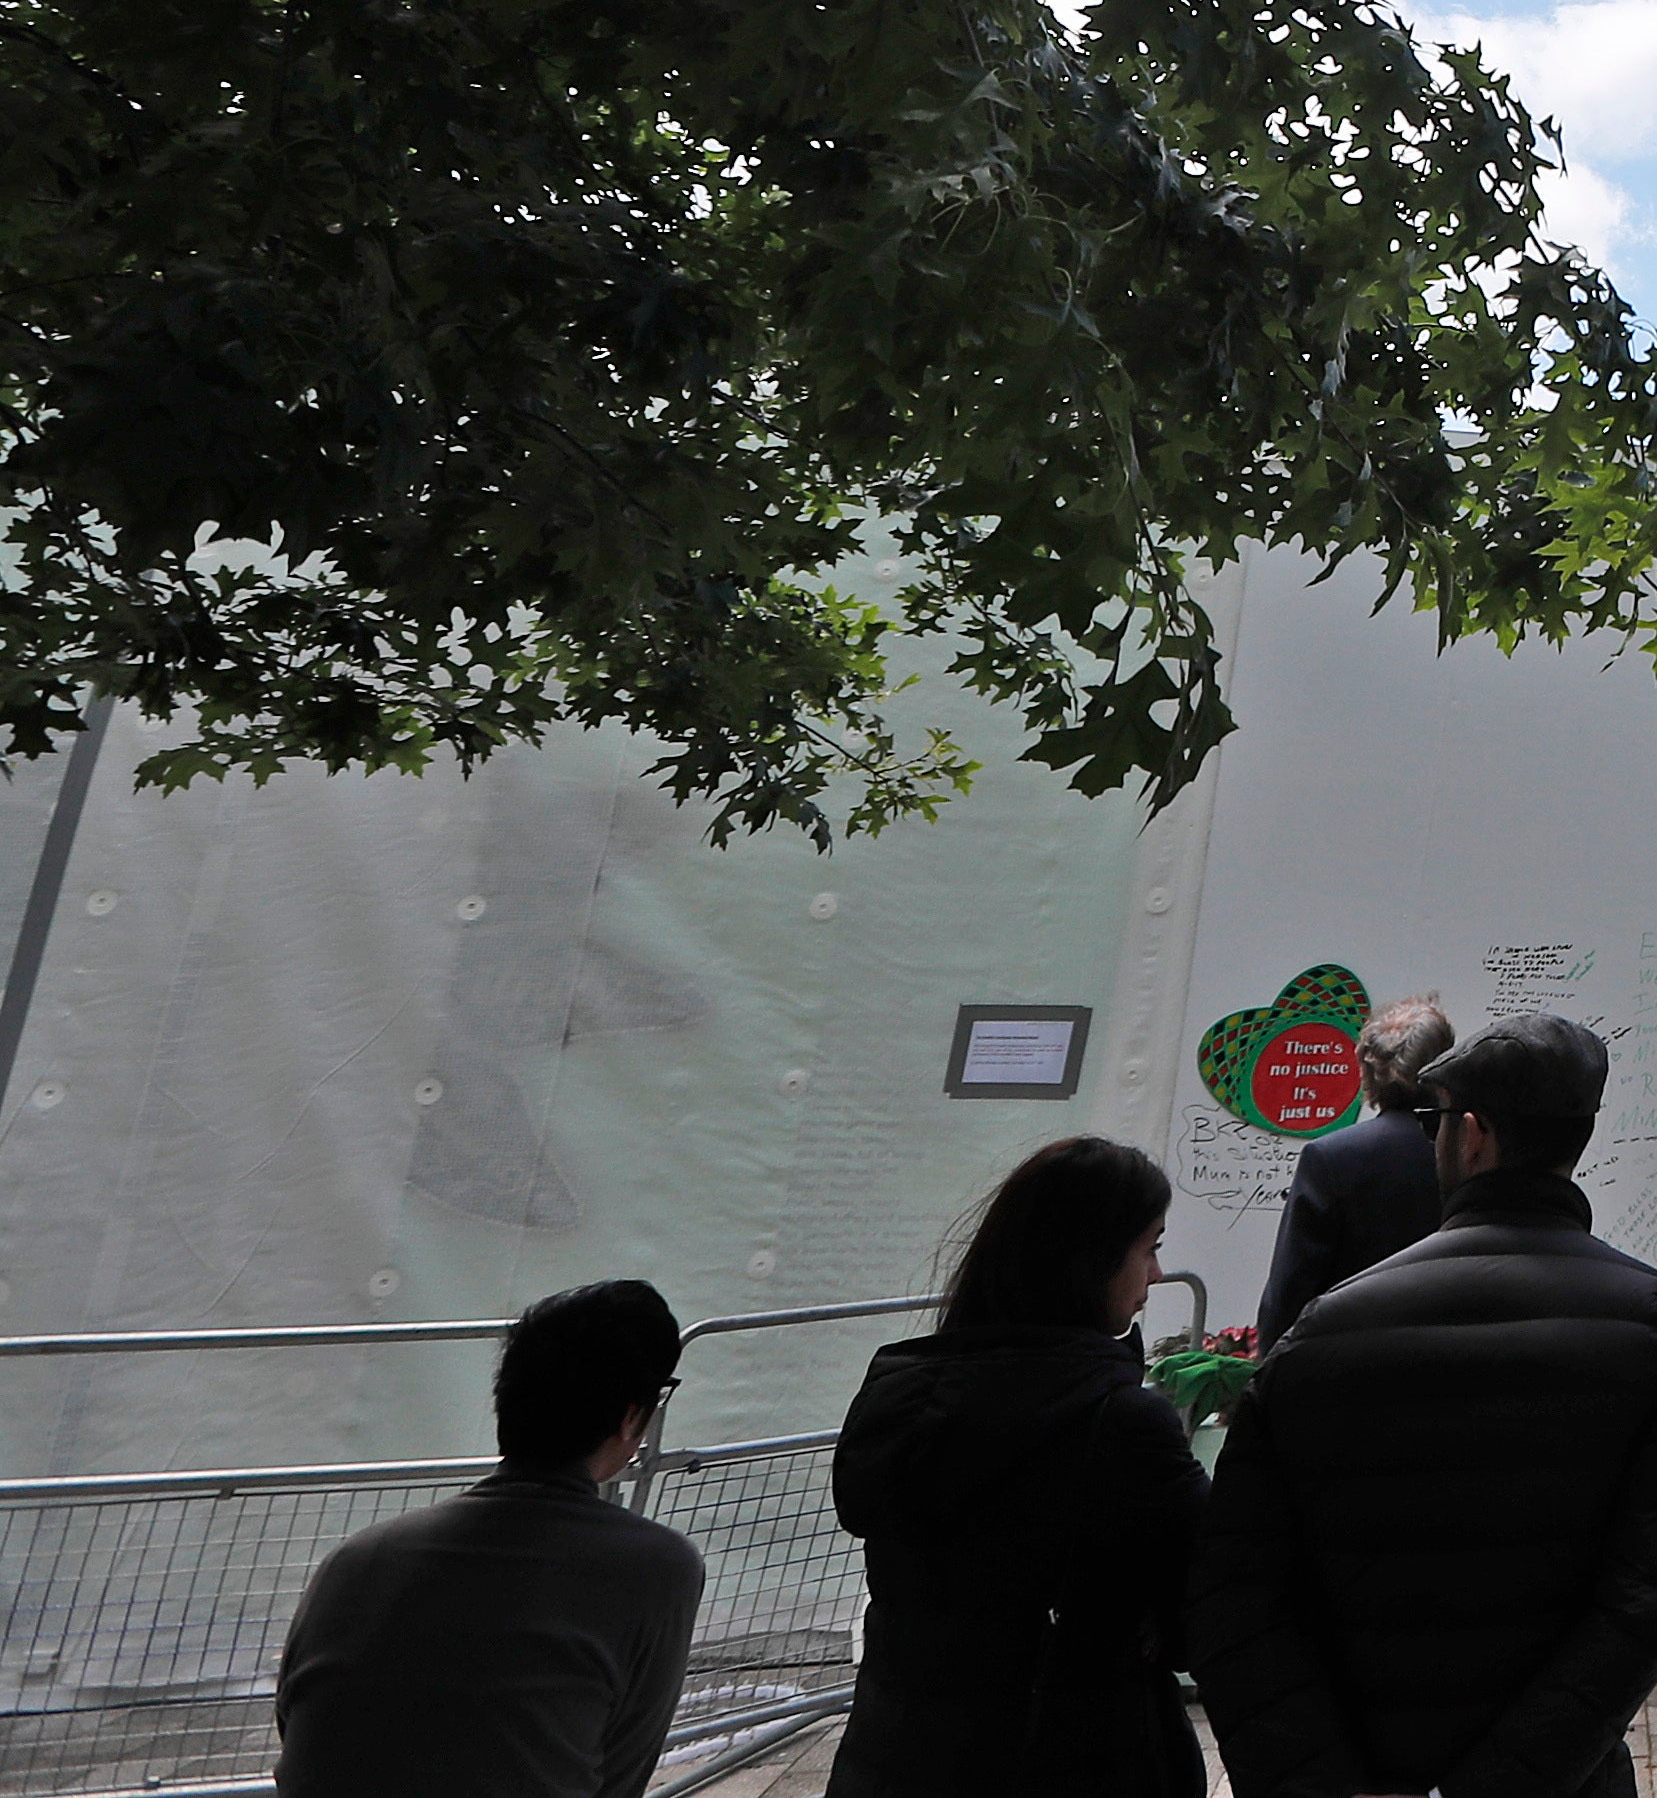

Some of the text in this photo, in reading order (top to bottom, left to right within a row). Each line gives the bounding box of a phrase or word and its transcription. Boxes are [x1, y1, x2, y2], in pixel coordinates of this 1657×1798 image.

[1284, 1040, 1345, 1056] There's
[1269, 1062, 1350, 1079] no justice
[1292, 1086, 1318, 1101] It's
[1279, 1104, 1337, 1123] just us
